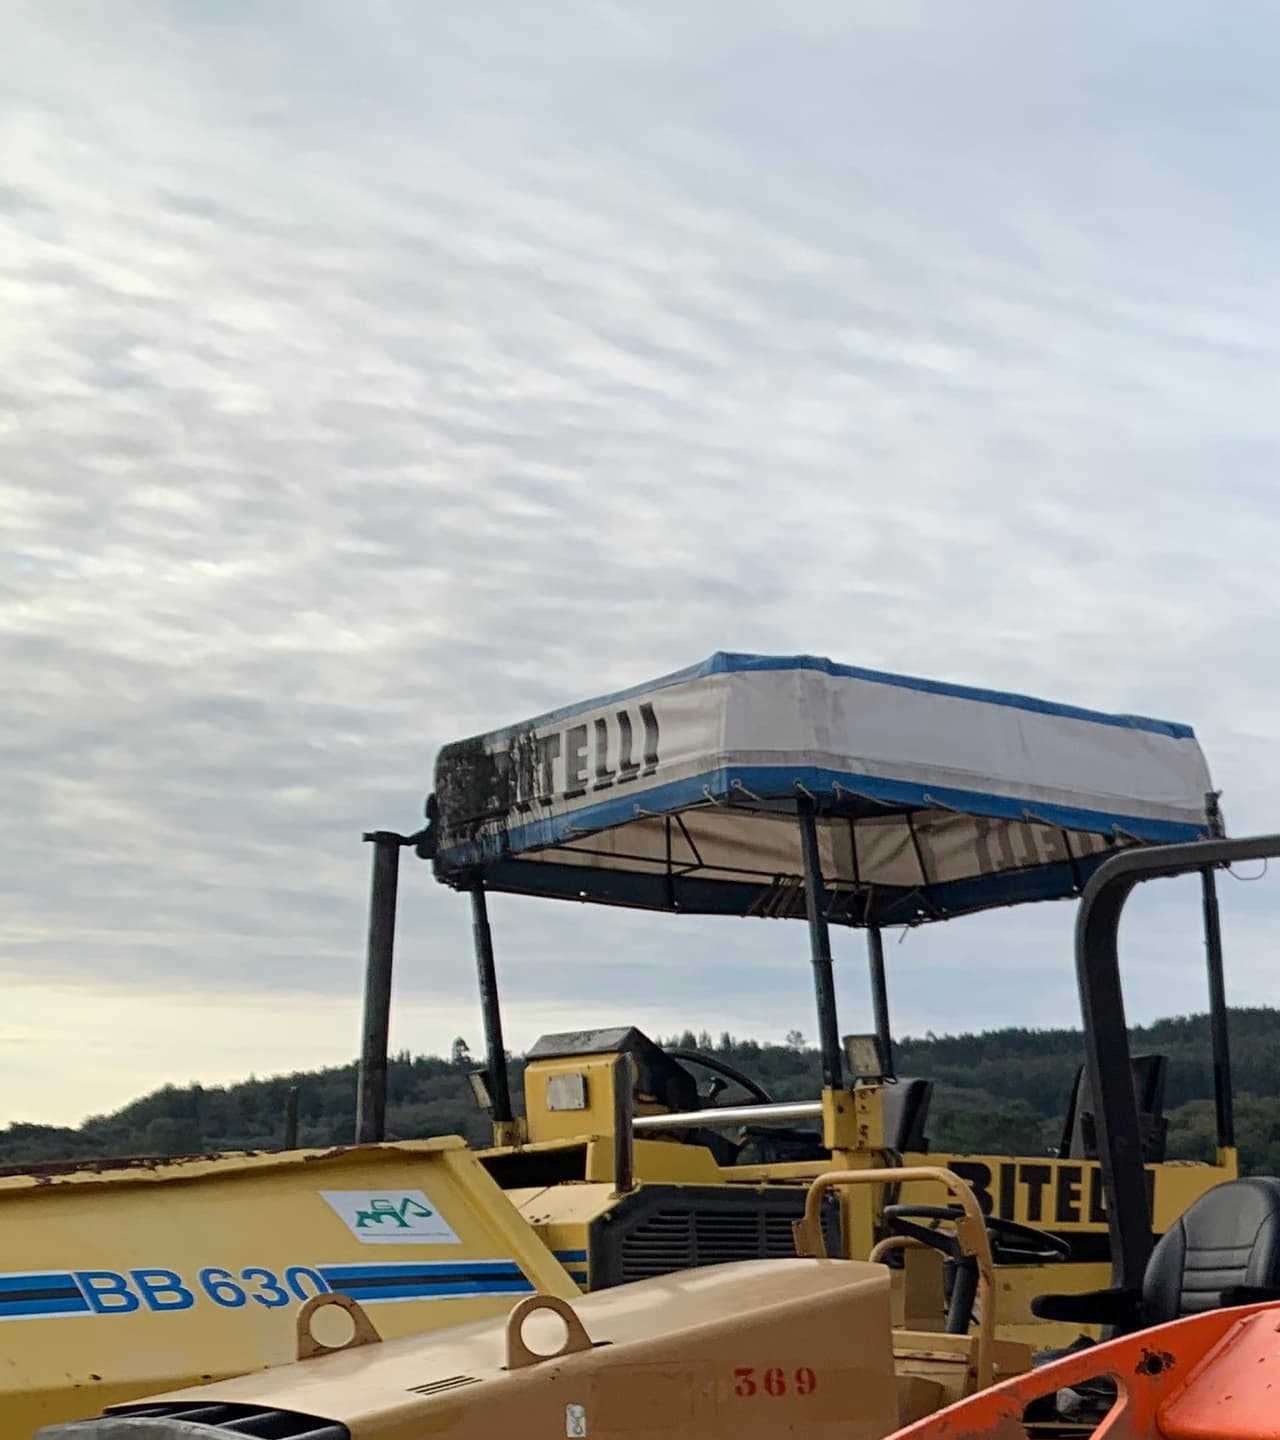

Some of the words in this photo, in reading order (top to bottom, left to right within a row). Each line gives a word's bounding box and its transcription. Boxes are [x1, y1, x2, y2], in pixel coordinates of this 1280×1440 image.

[73, 1270, 194, 1314] BB
[199, 1267, 332, 1309] 630
[733, 1367, 817, 1397] 369
